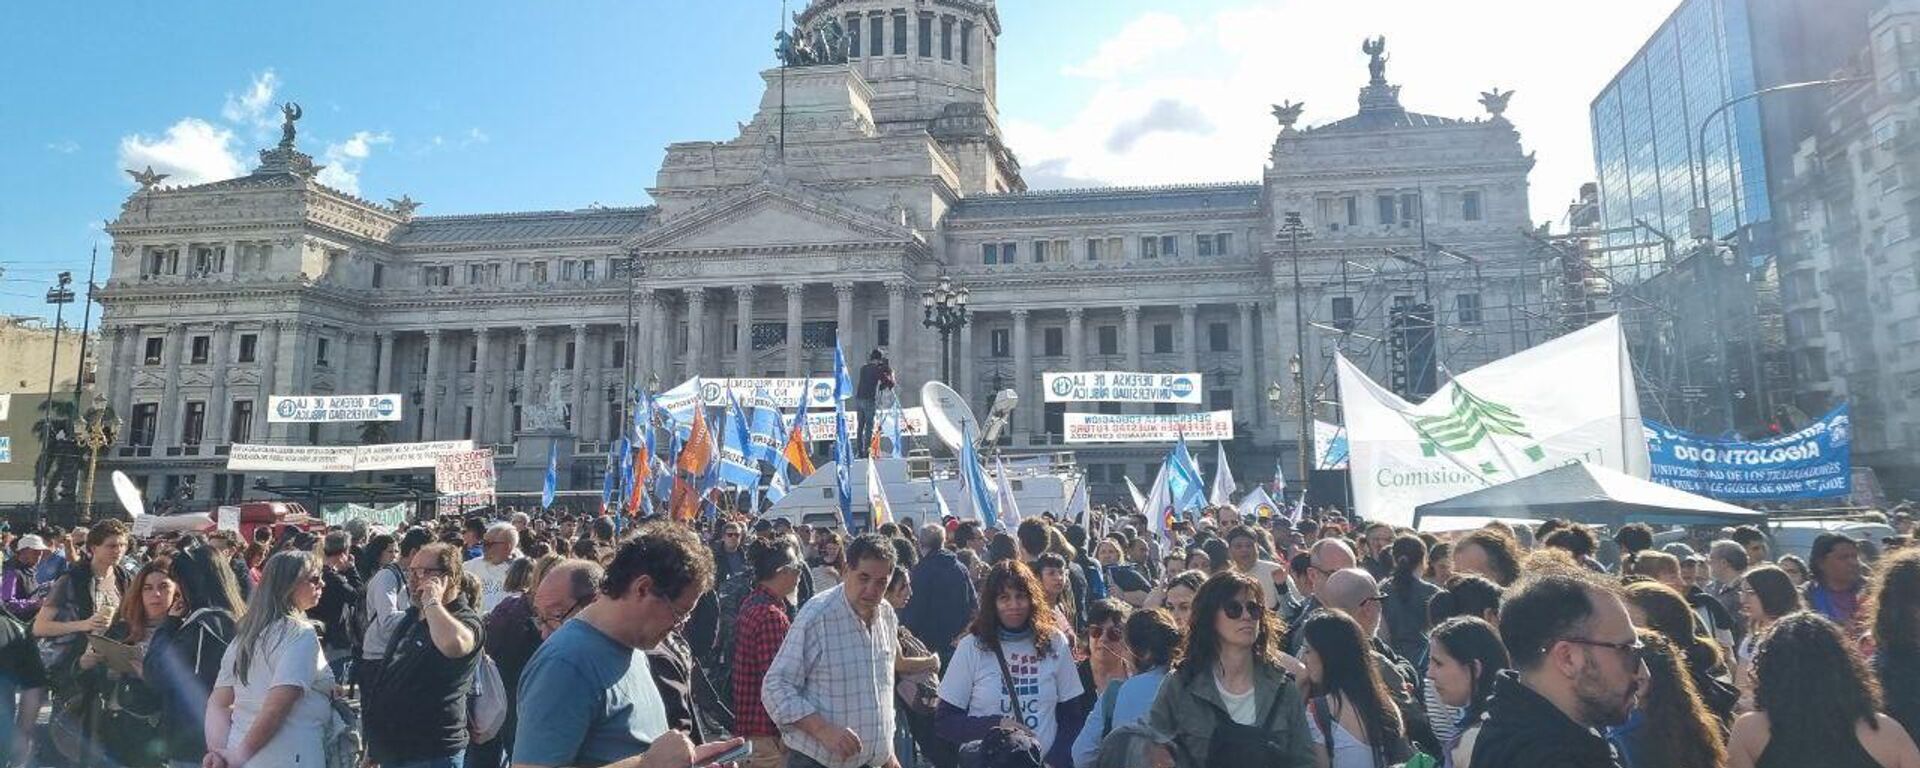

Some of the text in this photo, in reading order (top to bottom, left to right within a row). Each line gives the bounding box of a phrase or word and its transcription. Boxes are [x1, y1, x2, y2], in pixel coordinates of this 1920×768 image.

[1674, 440, 1820, 465] ODONTOLOGÍA
[1652, 463, 1725, 480] UNIVERSIDAD
[1726, 470, 1742, 480] DE
